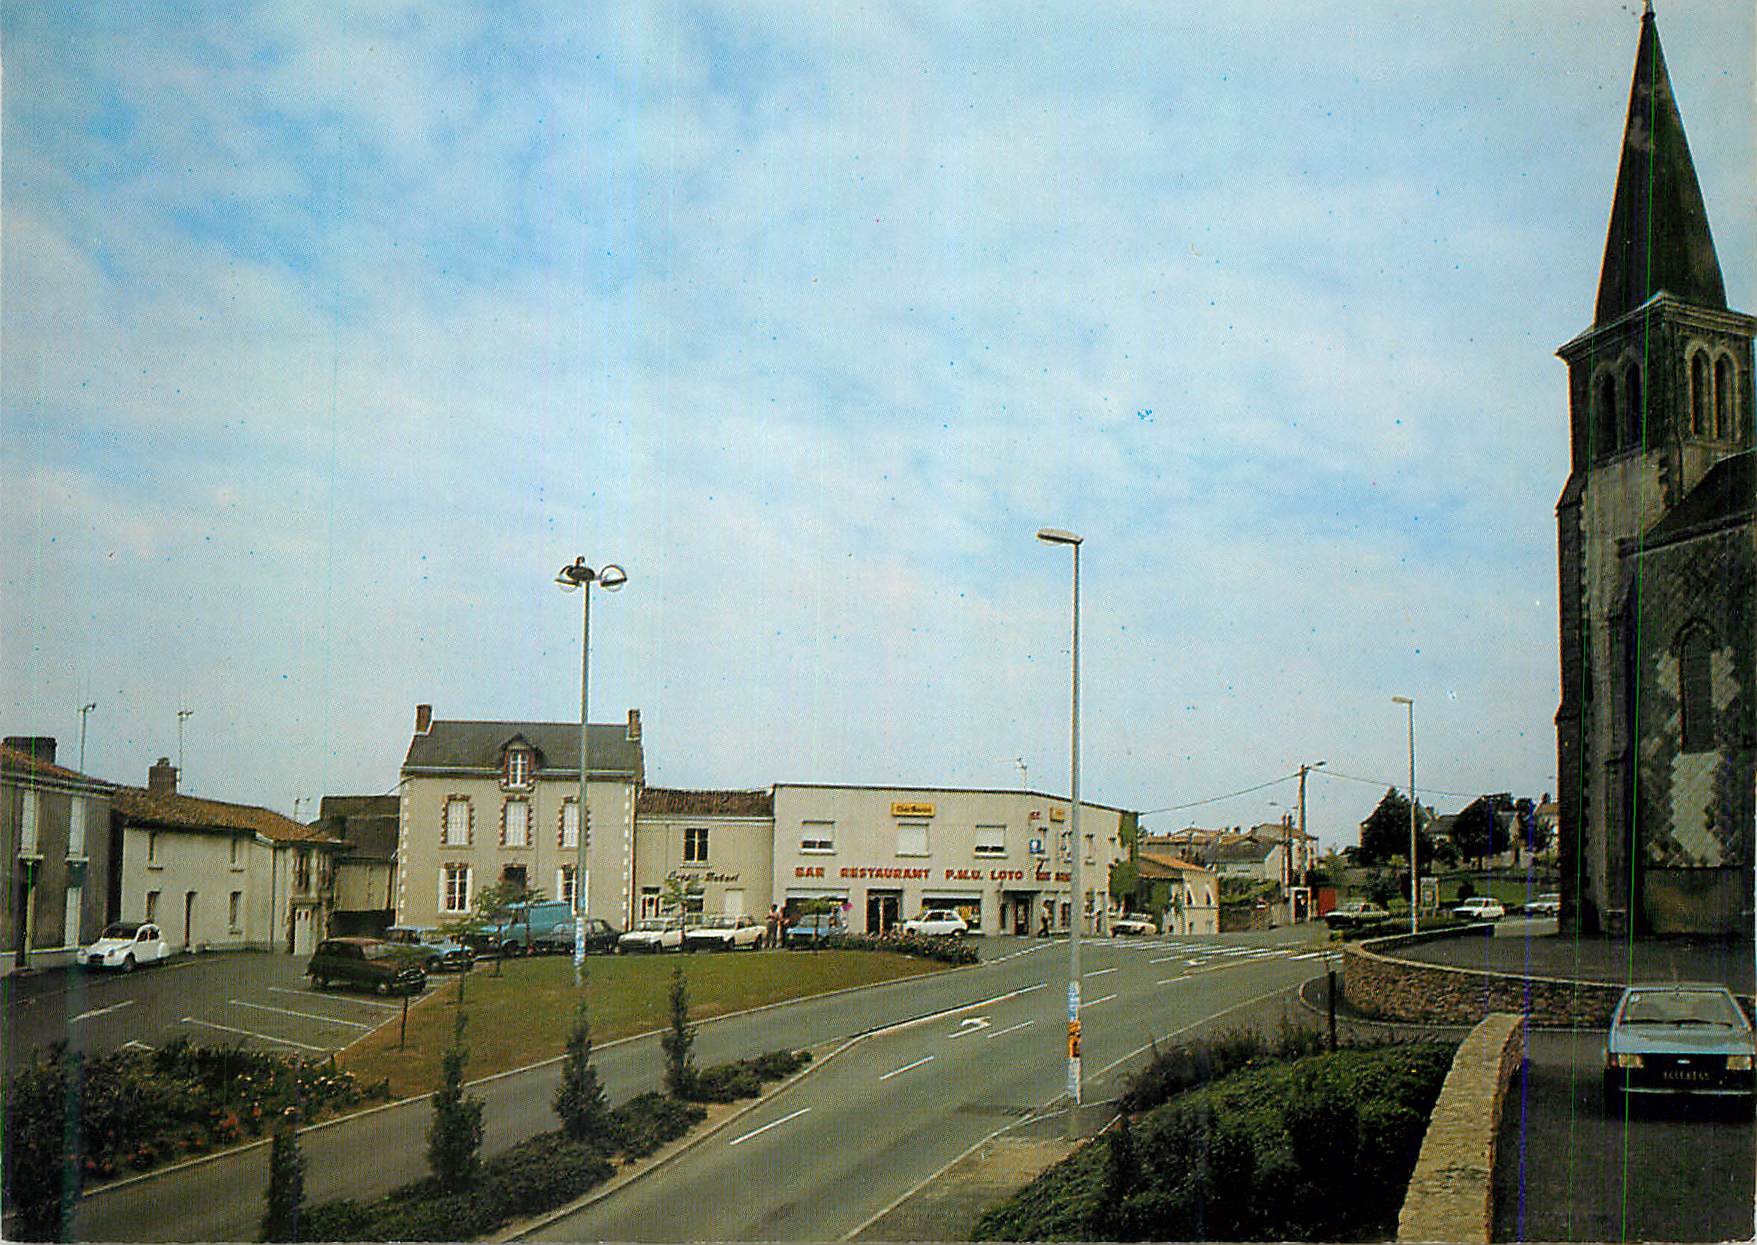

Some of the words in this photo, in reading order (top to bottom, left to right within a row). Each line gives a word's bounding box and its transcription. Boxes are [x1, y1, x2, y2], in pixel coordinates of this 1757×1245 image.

[795, 866, 825, 878] BAR
[840, 867, 930, 879] RESTAURANT
[990, 869, 1023, 881] LOTO
